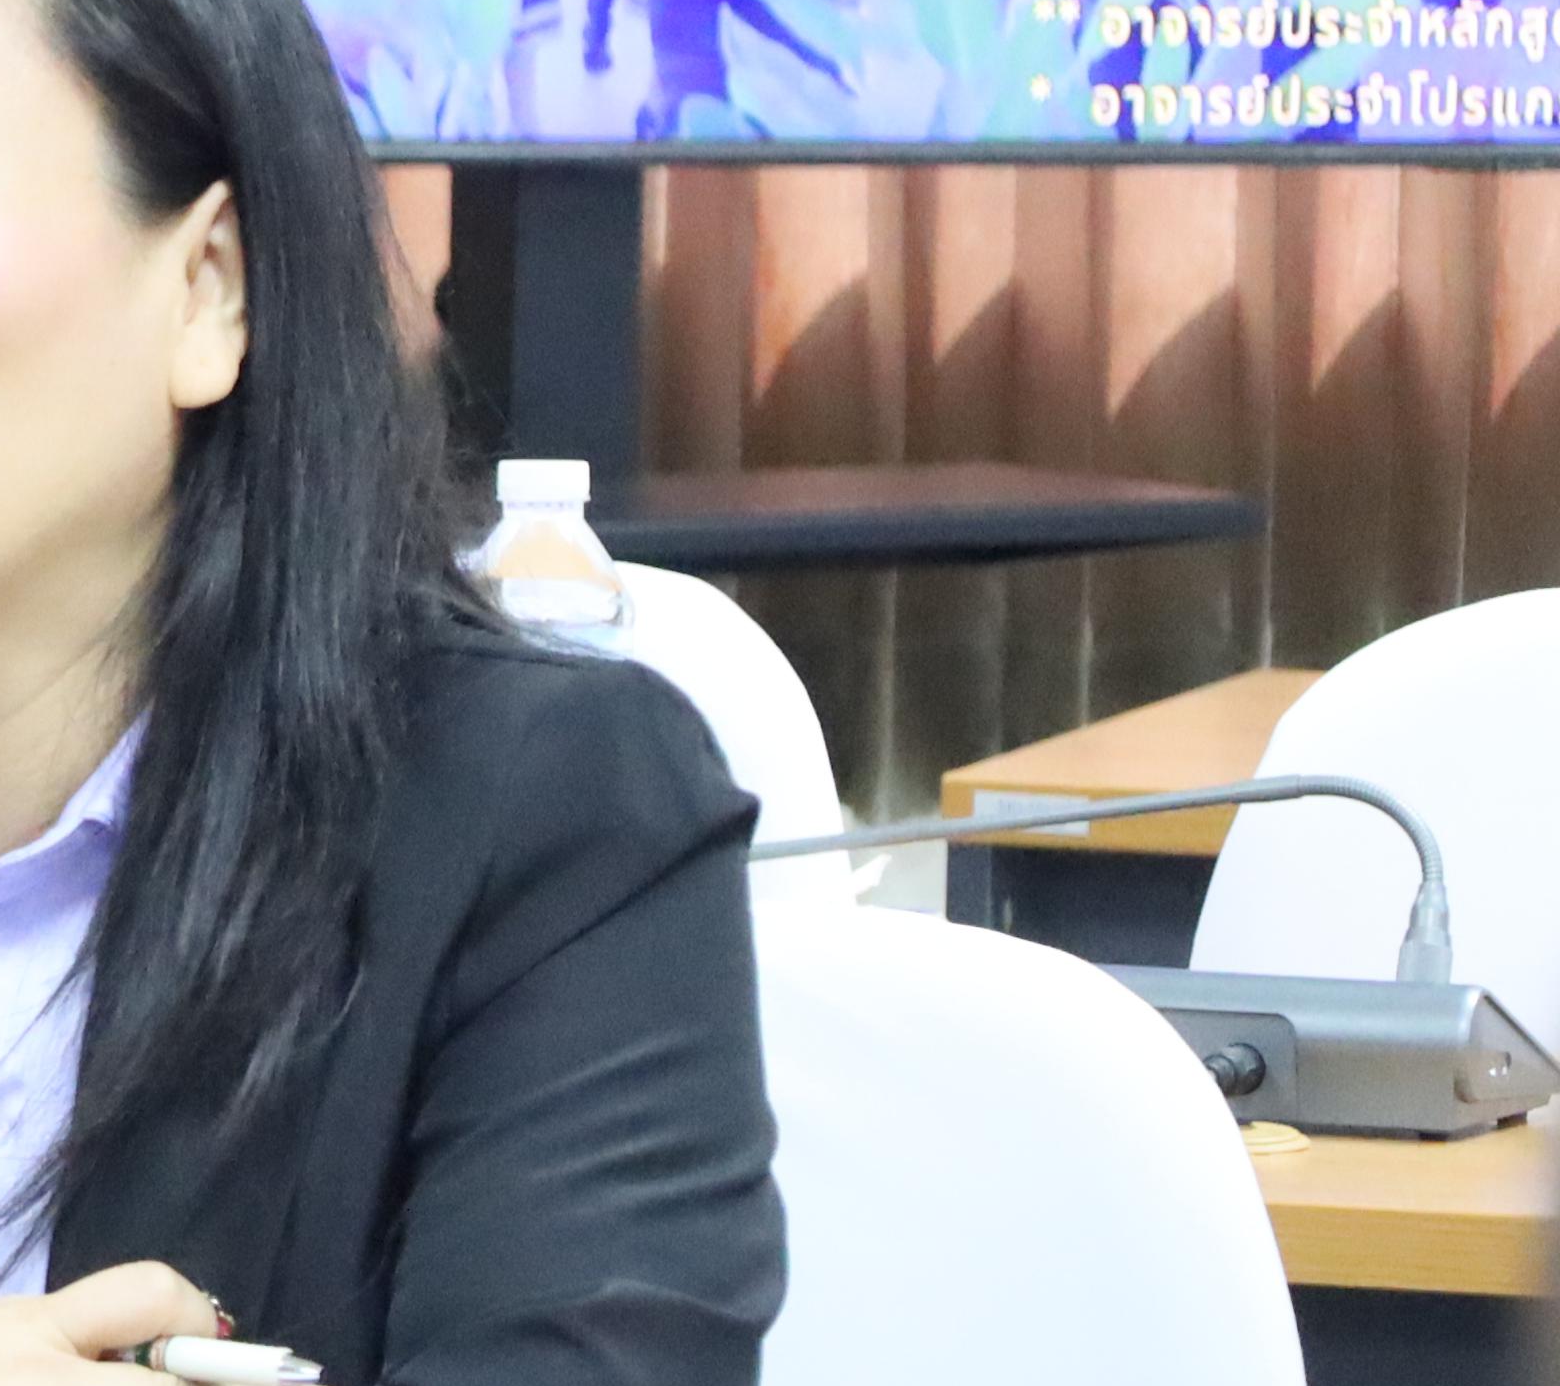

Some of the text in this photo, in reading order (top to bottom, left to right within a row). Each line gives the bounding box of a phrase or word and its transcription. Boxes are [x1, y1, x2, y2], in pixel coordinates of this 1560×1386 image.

[1094, 70, 1560, 124] อาจารย์ประจำโปรแก
